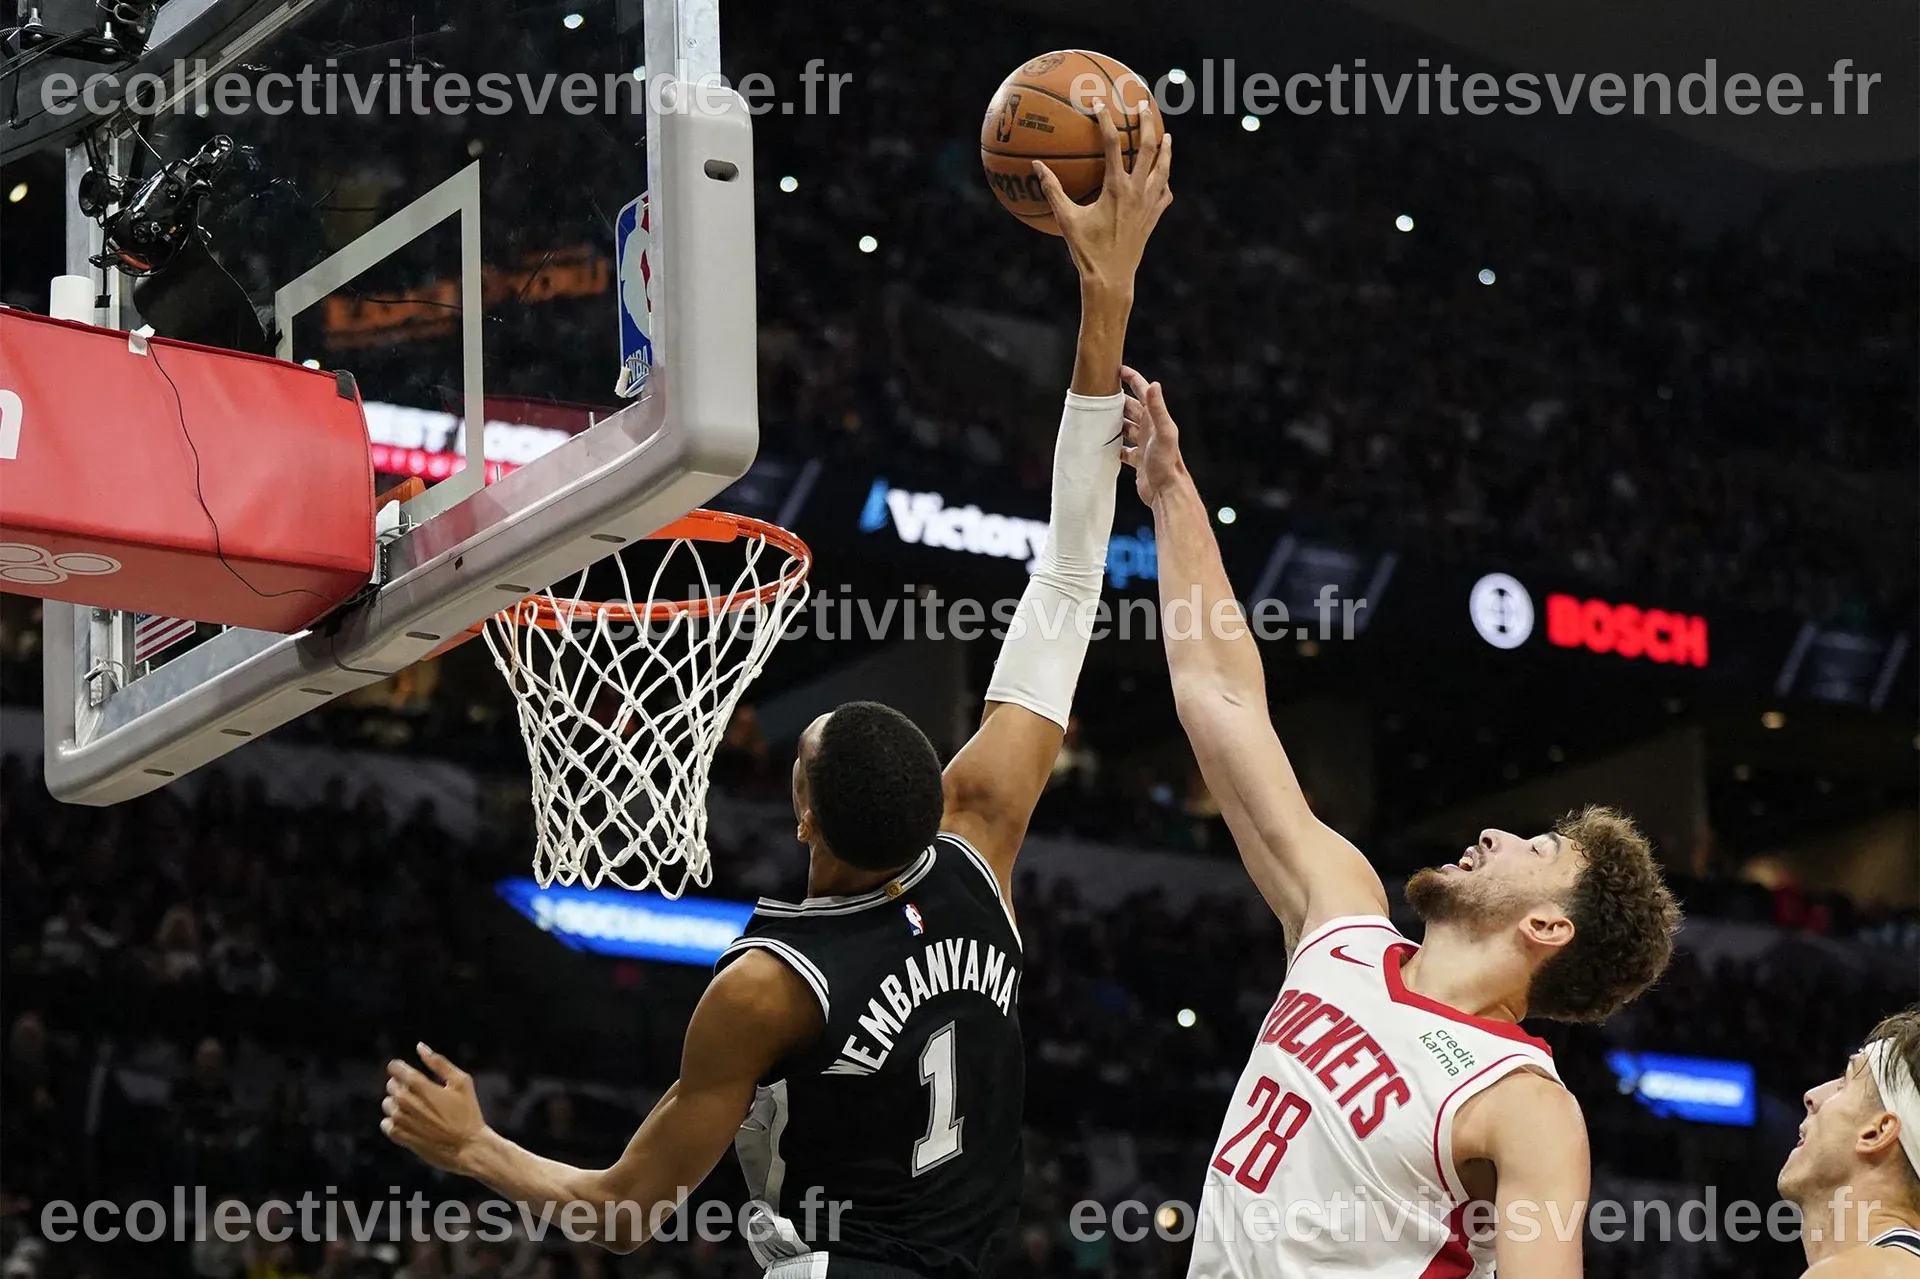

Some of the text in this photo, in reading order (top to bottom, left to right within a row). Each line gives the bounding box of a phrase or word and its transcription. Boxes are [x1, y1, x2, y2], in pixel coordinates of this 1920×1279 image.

[1546, 592, 1708, 668] BOSCH
[1418, 1031, 1459, 1077] karma
[1436, 1029, 1475, 1069] credit
[912, 1020, 964, 1178] 1
[1211, 1075, 1312, 1194] 28
